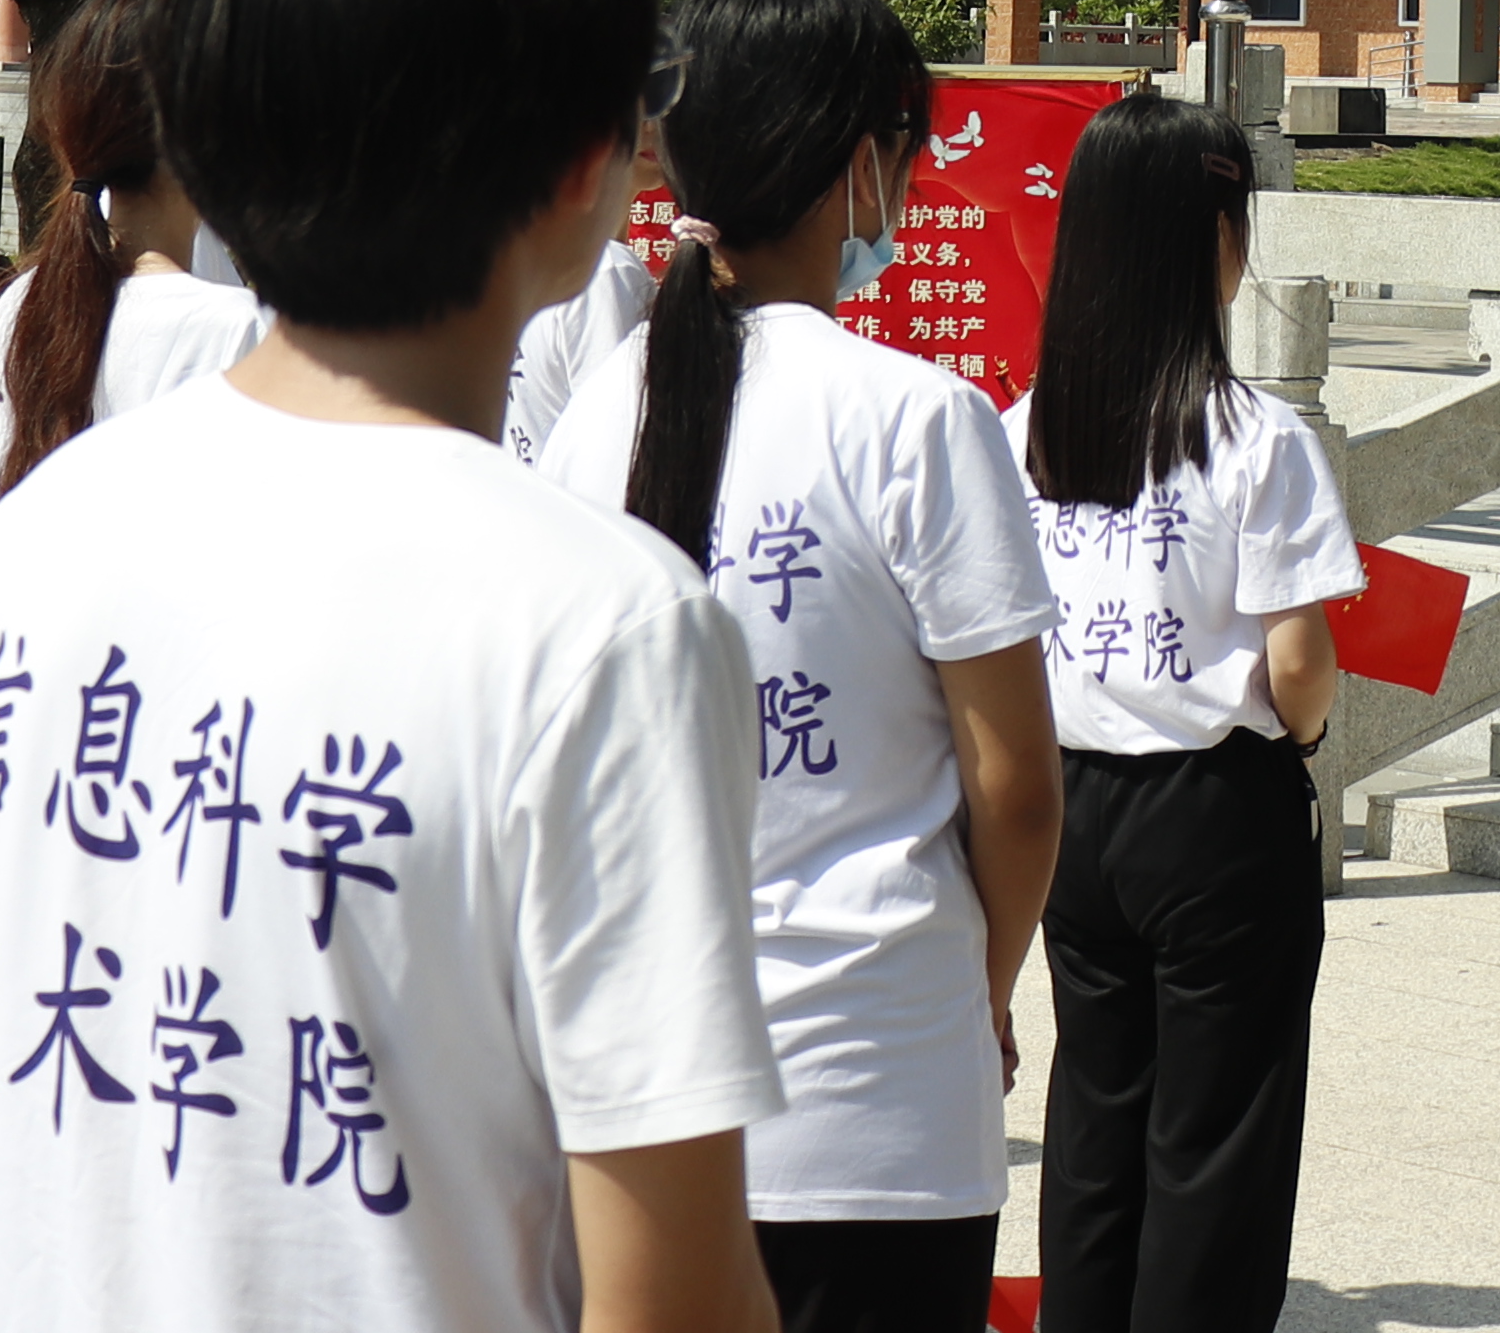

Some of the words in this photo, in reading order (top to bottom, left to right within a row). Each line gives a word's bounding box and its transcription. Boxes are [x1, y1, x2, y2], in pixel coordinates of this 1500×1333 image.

[628, 200, 676, 225] 志愿
[627, 236, 676, 262] 遵守
[840, 278, 986, 303] 律，保守党
[916, 353, 986, 378] 民牺
[756, 671, 838, 781] 院
